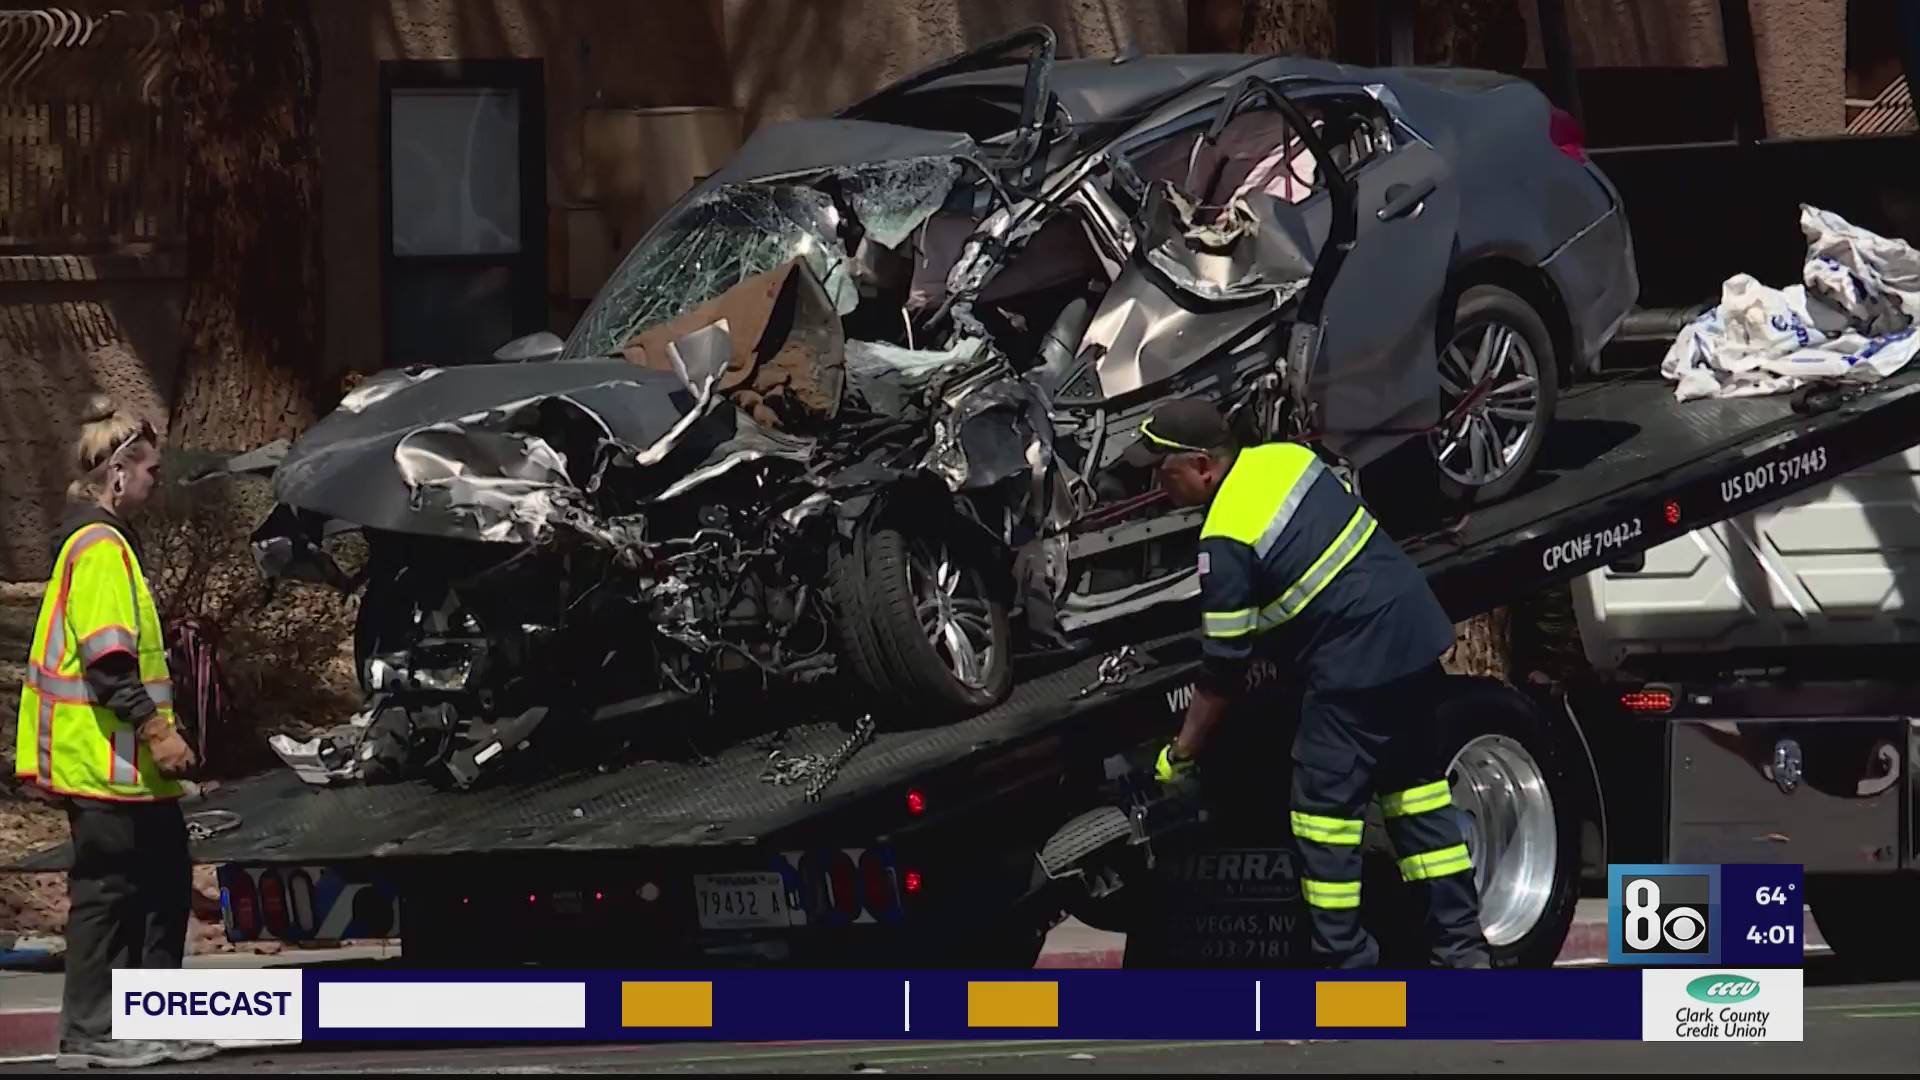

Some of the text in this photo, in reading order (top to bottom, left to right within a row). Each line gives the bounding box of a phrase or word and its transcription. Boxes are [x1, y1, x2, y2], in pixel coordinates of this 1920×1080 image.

[1721, 446, 1828, 503] US DOT 517443
[1543, 533, 1592, 572] CPCN#
[699, 890, 759, 916] 79432
[1268, 915, 1297, 933] NV
